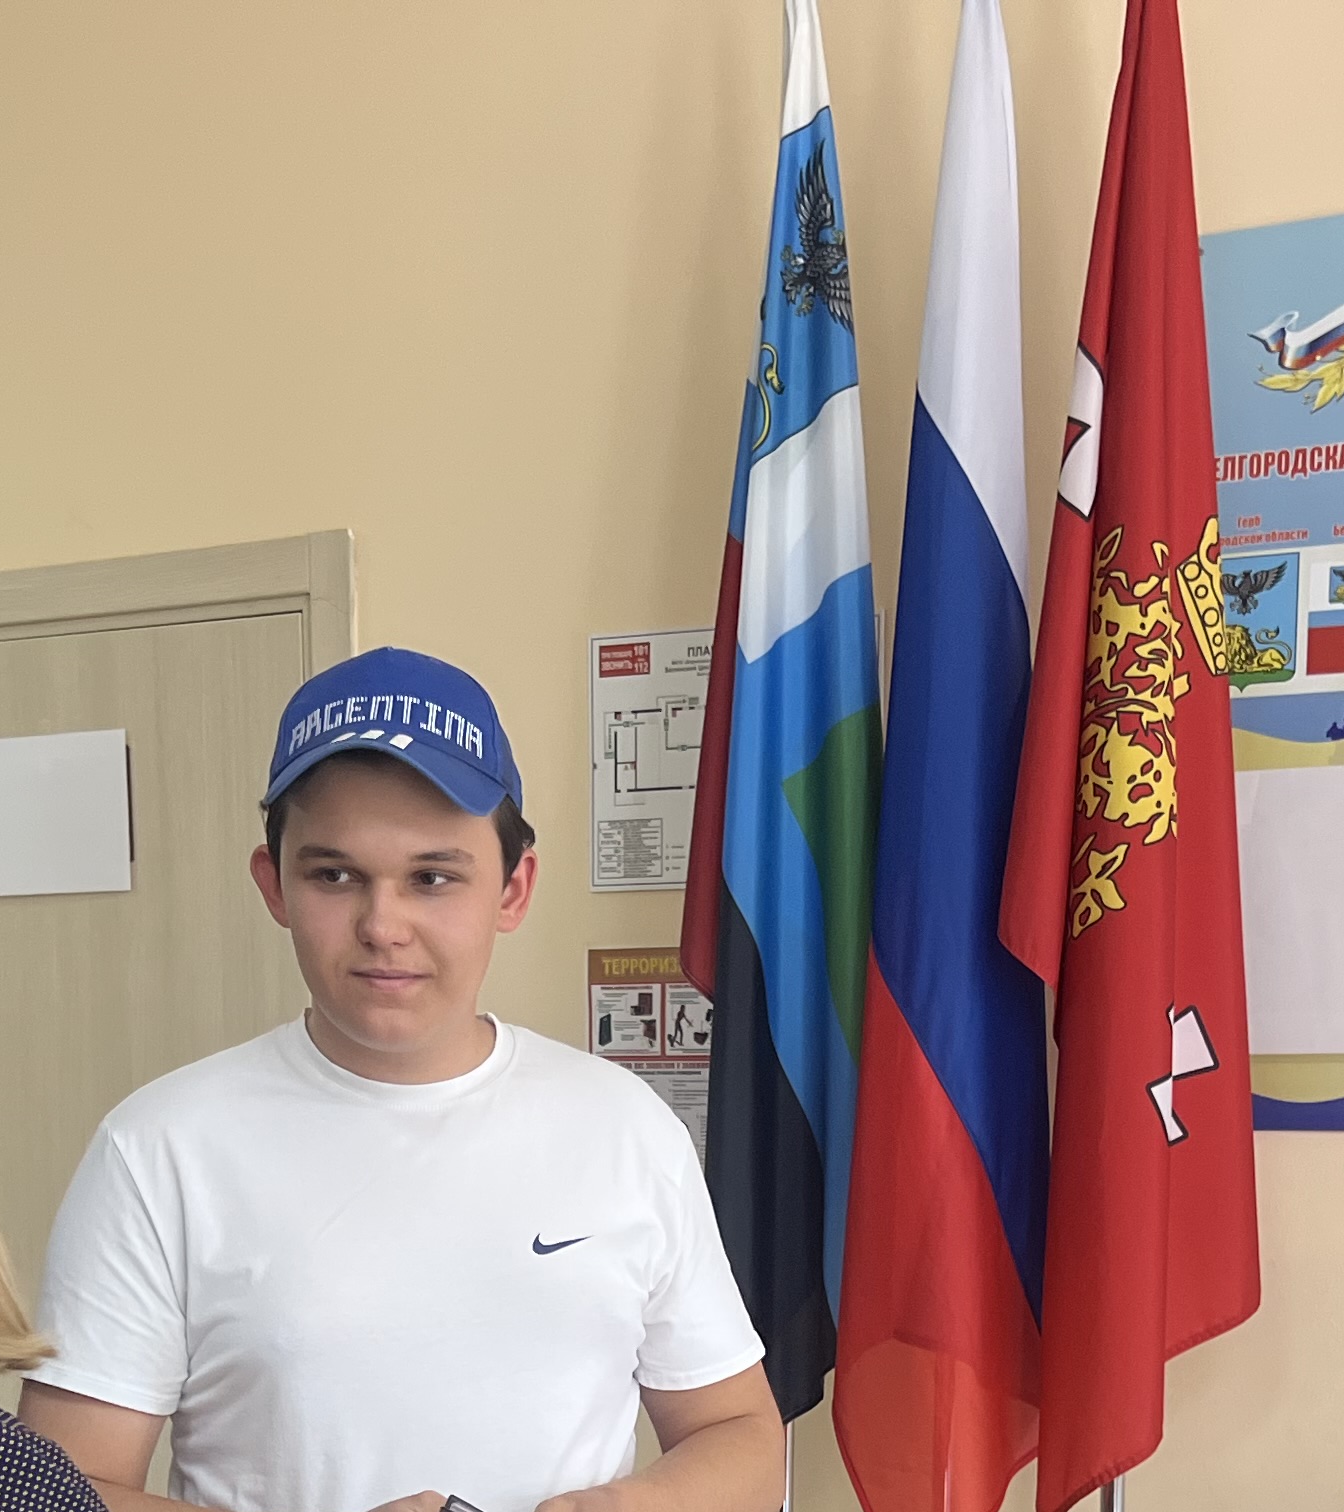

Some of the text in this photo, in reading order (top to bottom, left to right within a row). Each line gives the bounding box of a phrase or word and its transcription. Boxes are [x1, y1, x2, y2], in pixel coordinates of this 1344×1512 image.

[687, 645, 711, 657] ПЛА
[288, 694, 484, 760] ARGENTINA
[602, 956, 680, 976] ТЕРРОРИЗ
